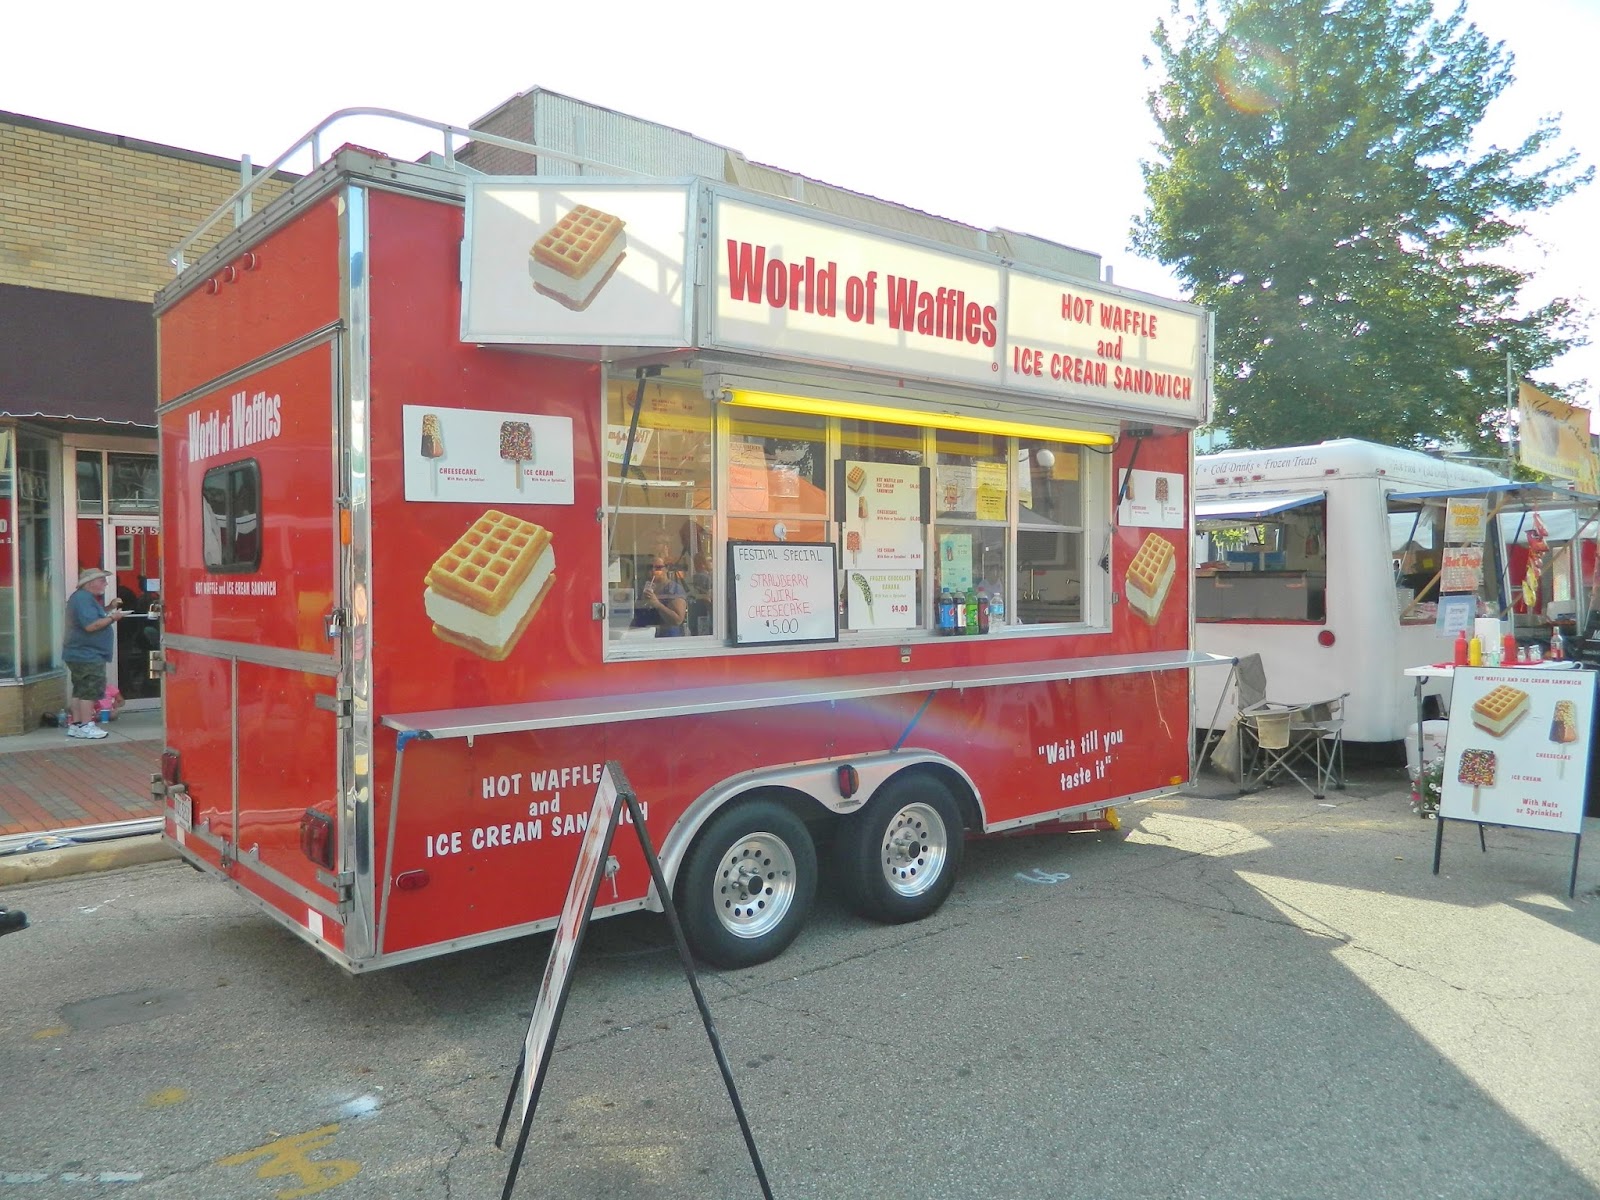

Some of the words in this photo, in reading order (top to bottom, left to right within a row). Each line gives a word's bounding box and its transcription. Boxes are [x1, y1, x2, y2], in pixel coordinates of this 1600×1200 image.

[726, 239, 837, 318] World
[845, 271, 878, 325] of
[886, 274, 998, 348] Waffles
[1061, 293, 1094, 325] HOT
[1100, 304, 1158, 339] WAFFLE
[1097, 335, 1124, 362] and
[1013, 345, 1044, 377] ICE
[1050, 353, 1108, 388] CREAM
[1113, 365, 1193, 401] SANDWICH
[188, 410, 220, 462] World
[222, 415, 230, 453] of
[232, 390, 281, 450] Waffles
[439, 467, 477, 476] CHEESECAKE
[1210, 461, 1228, 475] Cold
[1229, 460, 1254, 473] Drinks
[1264, 458, 1290, 469] Frozen
[1293, 456, 1318, 466] Treats
[738, 548, 778, 561] FESTIVAL
[784, 549, 823, 561] SPECIAL
[204, 582, 218, 594] WAFFLE
[235, 582, 250, 595] CREAM
[251, 581, 276, 596] SANDWICH
[750, 573, 809, 588] STRAWBERRY
[764, 589, 799, 603] SWIRL
[748, 602, 811, 618] CHEESECAKE
[764, 618, 798, 634] $5.00
[1038, 739, 1075, 765] "Wait
[1081, 730, 1098, 754] till
[1104, 729, 1123, 753] you
[1536, 752, 1571, 760] CHEESECAKE
[482, 774, 522, 799] HOT
[531, 763, 602, 792] WAFFLE
[1060, 767, 1091, 791] taste
[1096, 755, 1111, 779] it"
[529, 792, 560, 816] and
[1522, 798, 1539, 806] With
[1542, 799, 1558, 808] Nuts
[1526, 808, 1563, 818] Sprinkles!
[426, 832, 462, 858] ICE
[472, 819, 542, 850] CREAM
[551, 802, 648, 837] SANICH
